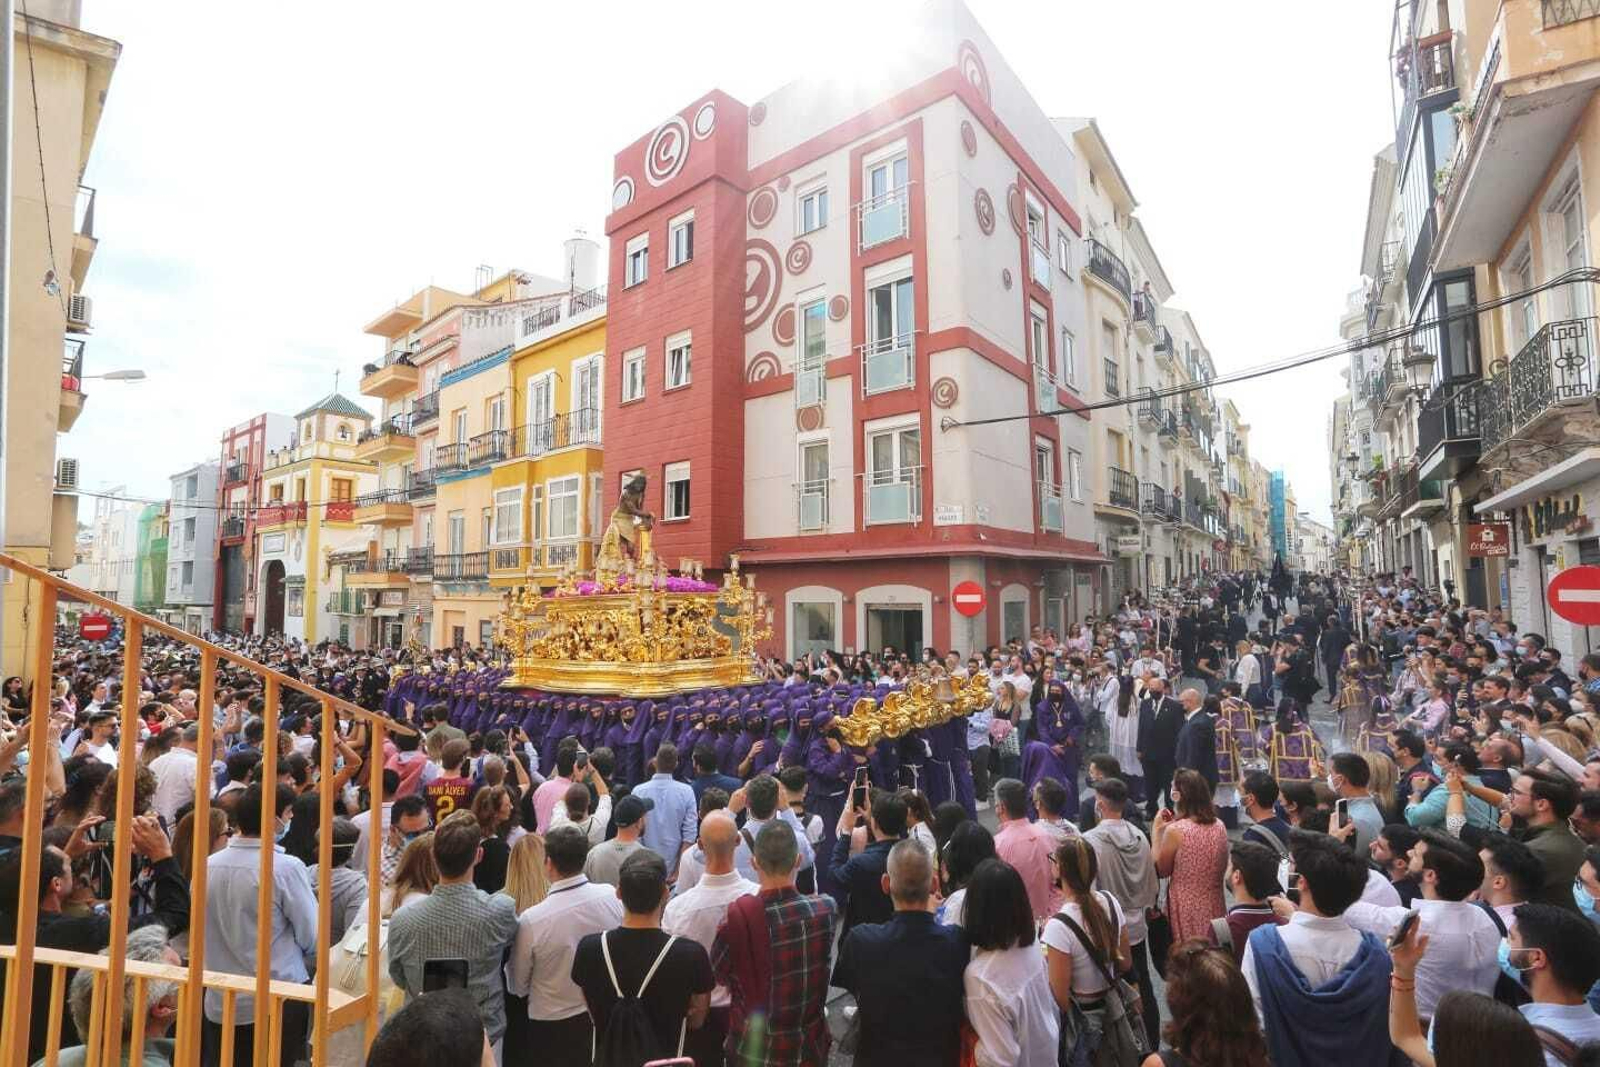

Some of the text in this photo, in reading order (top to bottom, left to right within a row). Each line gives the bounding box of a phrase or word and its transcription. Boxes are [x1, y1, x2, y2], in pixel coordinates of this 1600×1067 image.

[428, 785, 466, 796] DANI ALVES
[436, 795, 455, 824] 2
